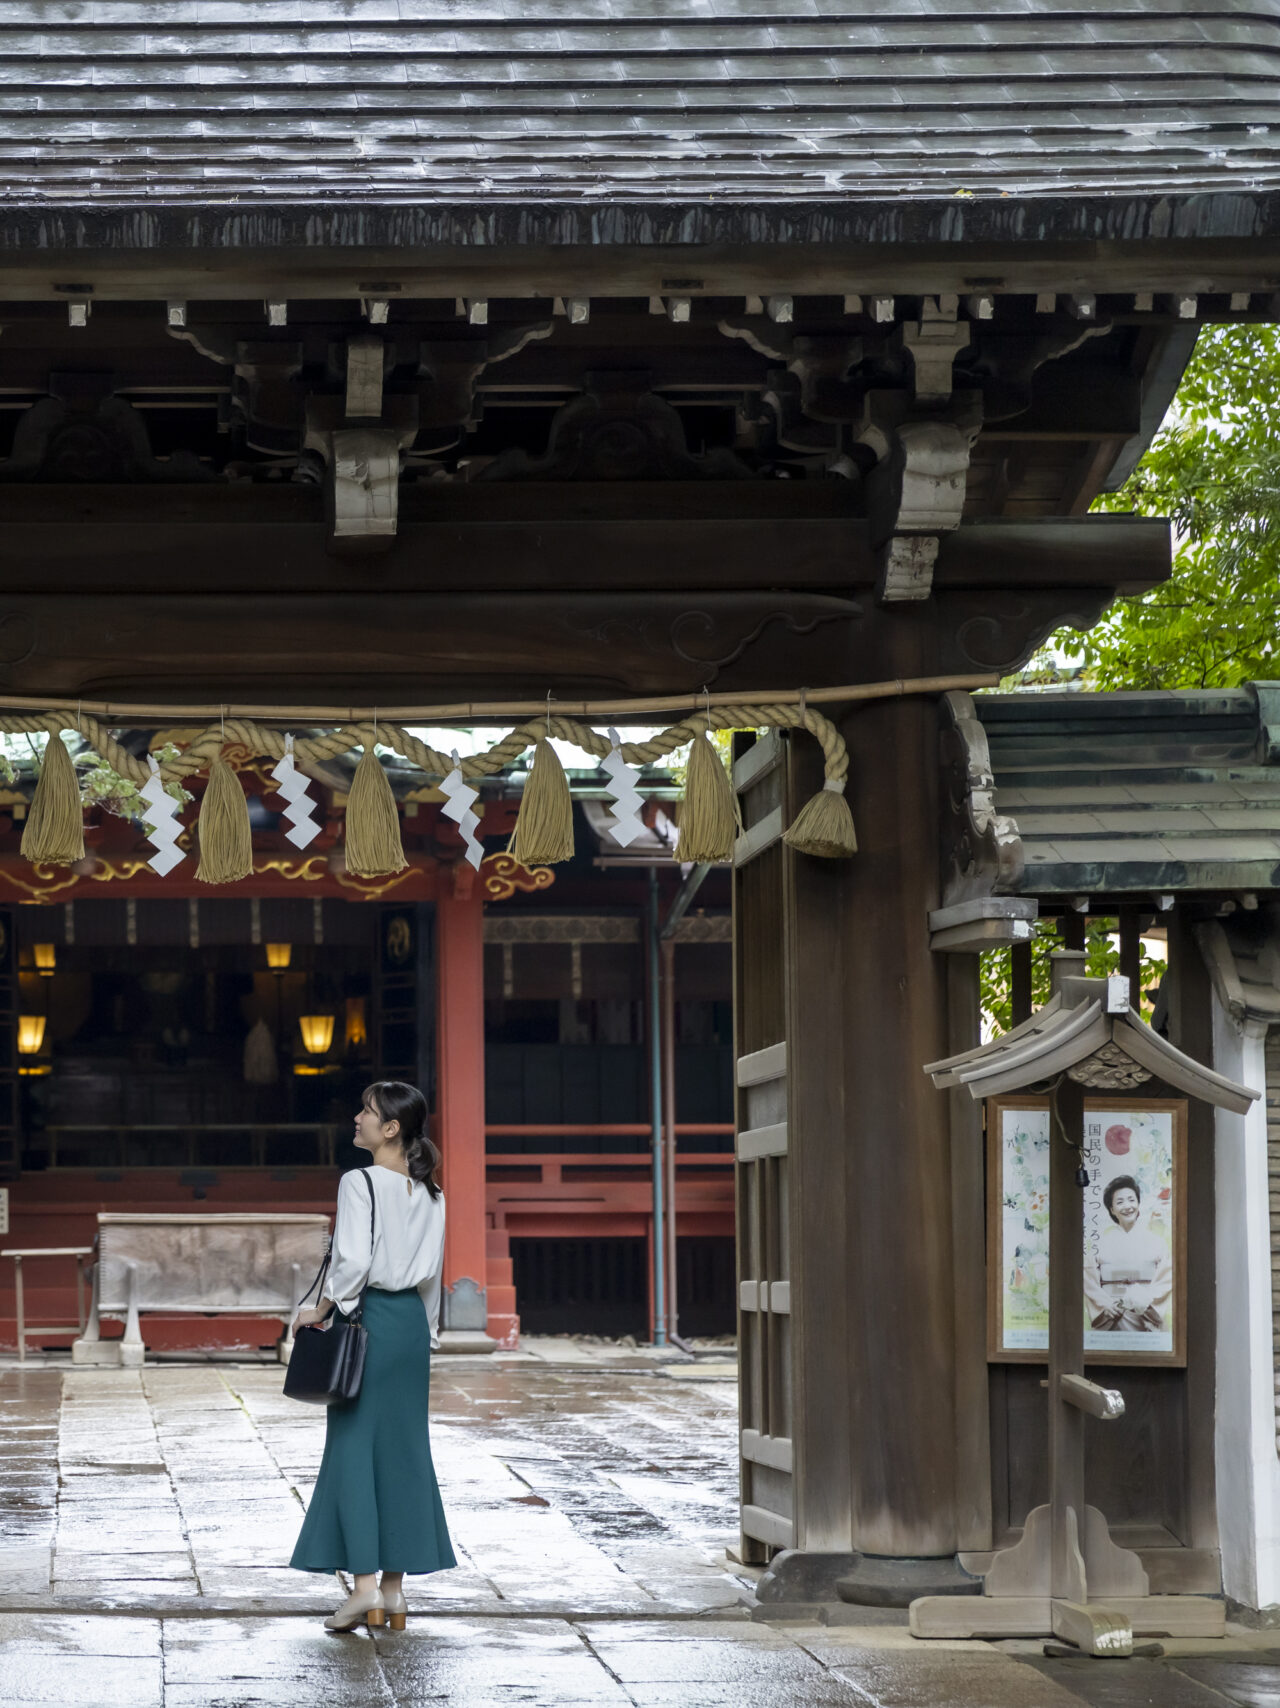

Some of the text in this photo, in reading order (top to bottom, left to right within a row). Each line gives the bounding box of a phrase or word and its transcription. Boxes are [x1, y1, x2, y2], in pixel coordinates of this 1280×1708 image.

[1088, 1123, 1102, 1256] 国民の手でつくろう
